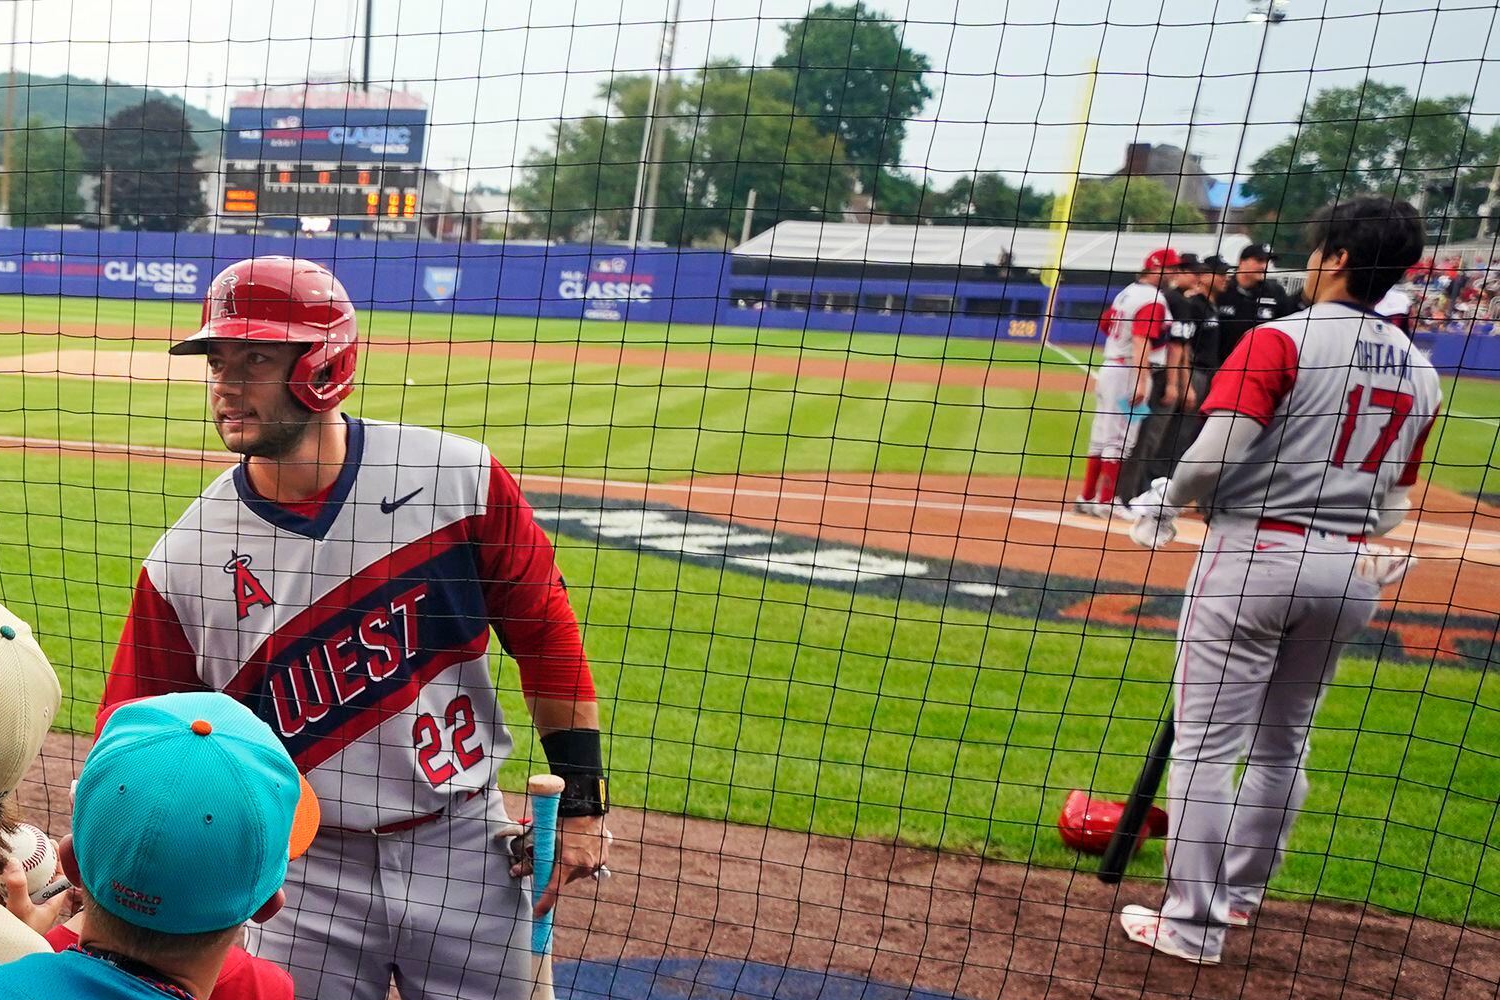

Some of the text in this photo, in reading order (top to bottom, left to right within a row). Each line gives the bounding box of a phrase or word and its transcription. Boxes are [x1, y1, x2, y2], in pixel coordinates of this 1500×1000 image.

[1331, 384, 1415, 474] 17
[223, 549, 277, 622] A
[269, 582, 429, 738] WEST
[412, 694, 485, 790] 22
[111, 879, 162, 906] WORLD
